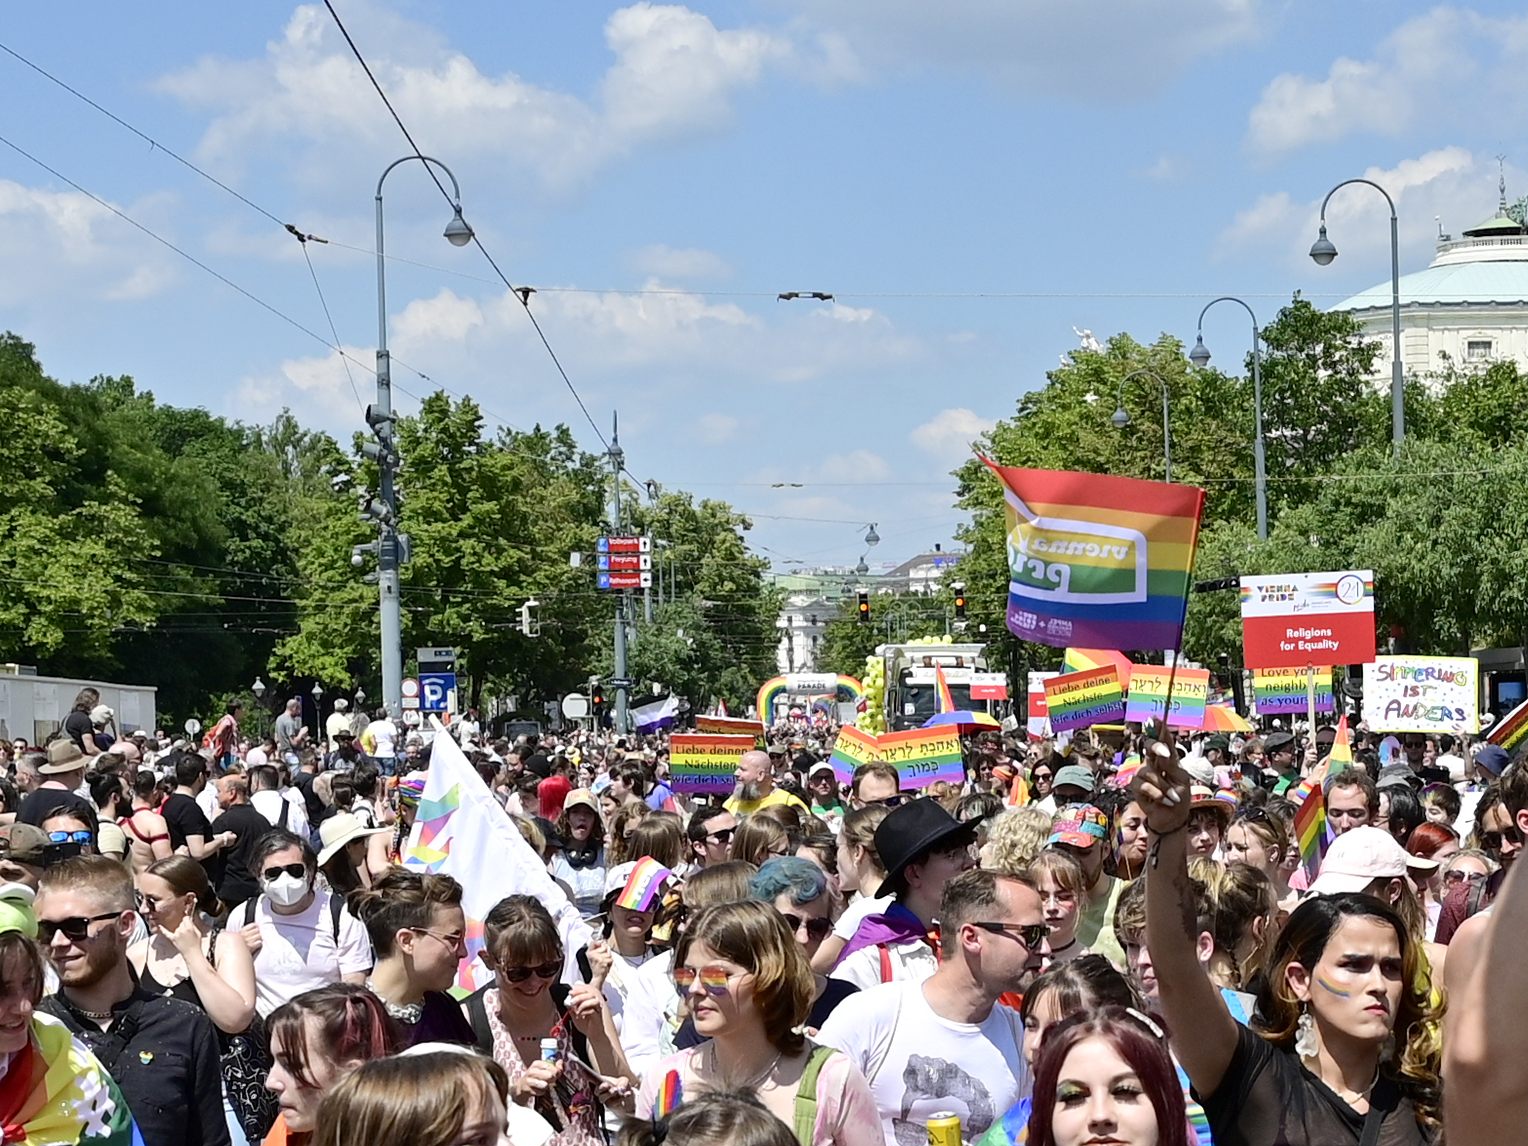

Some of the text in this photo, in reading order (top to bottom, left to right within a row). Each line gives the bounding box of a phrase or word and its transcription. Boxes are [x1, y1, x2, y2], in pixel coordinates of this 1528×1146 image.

[1257, 584, 1299, 594] VIENNA
[1260, 593, 1295, 602] PRIDE
[1286, 628, 1332, 640] Religions
[1280, 639, 1340, 652] for Equality
[1261, 667, 1289, 677] Love
[1376, 662, 1467, 686] SIMMERING
[1052, 677, 1111, 696] Liebe deine
[1265, 679, 1320, 694] neighbr
[1402, 685, 1438, 698] IST
[424, 685, 443, 708] P
[1062, 691, 1103, 707] Nächste
[1260, 696, 1275, 706] as
[1071, 708, 1092, 721] dich
[1095, 700, 1123, 716] selbst
[1384, 699, 1467, 721] ANDERS
[675, 745, 748, 756] Liebe deinen
[684, 758, 737, 770] Nächsten
[672, 774, 692, 784] wie
[694, 774, 718, 784] dich
